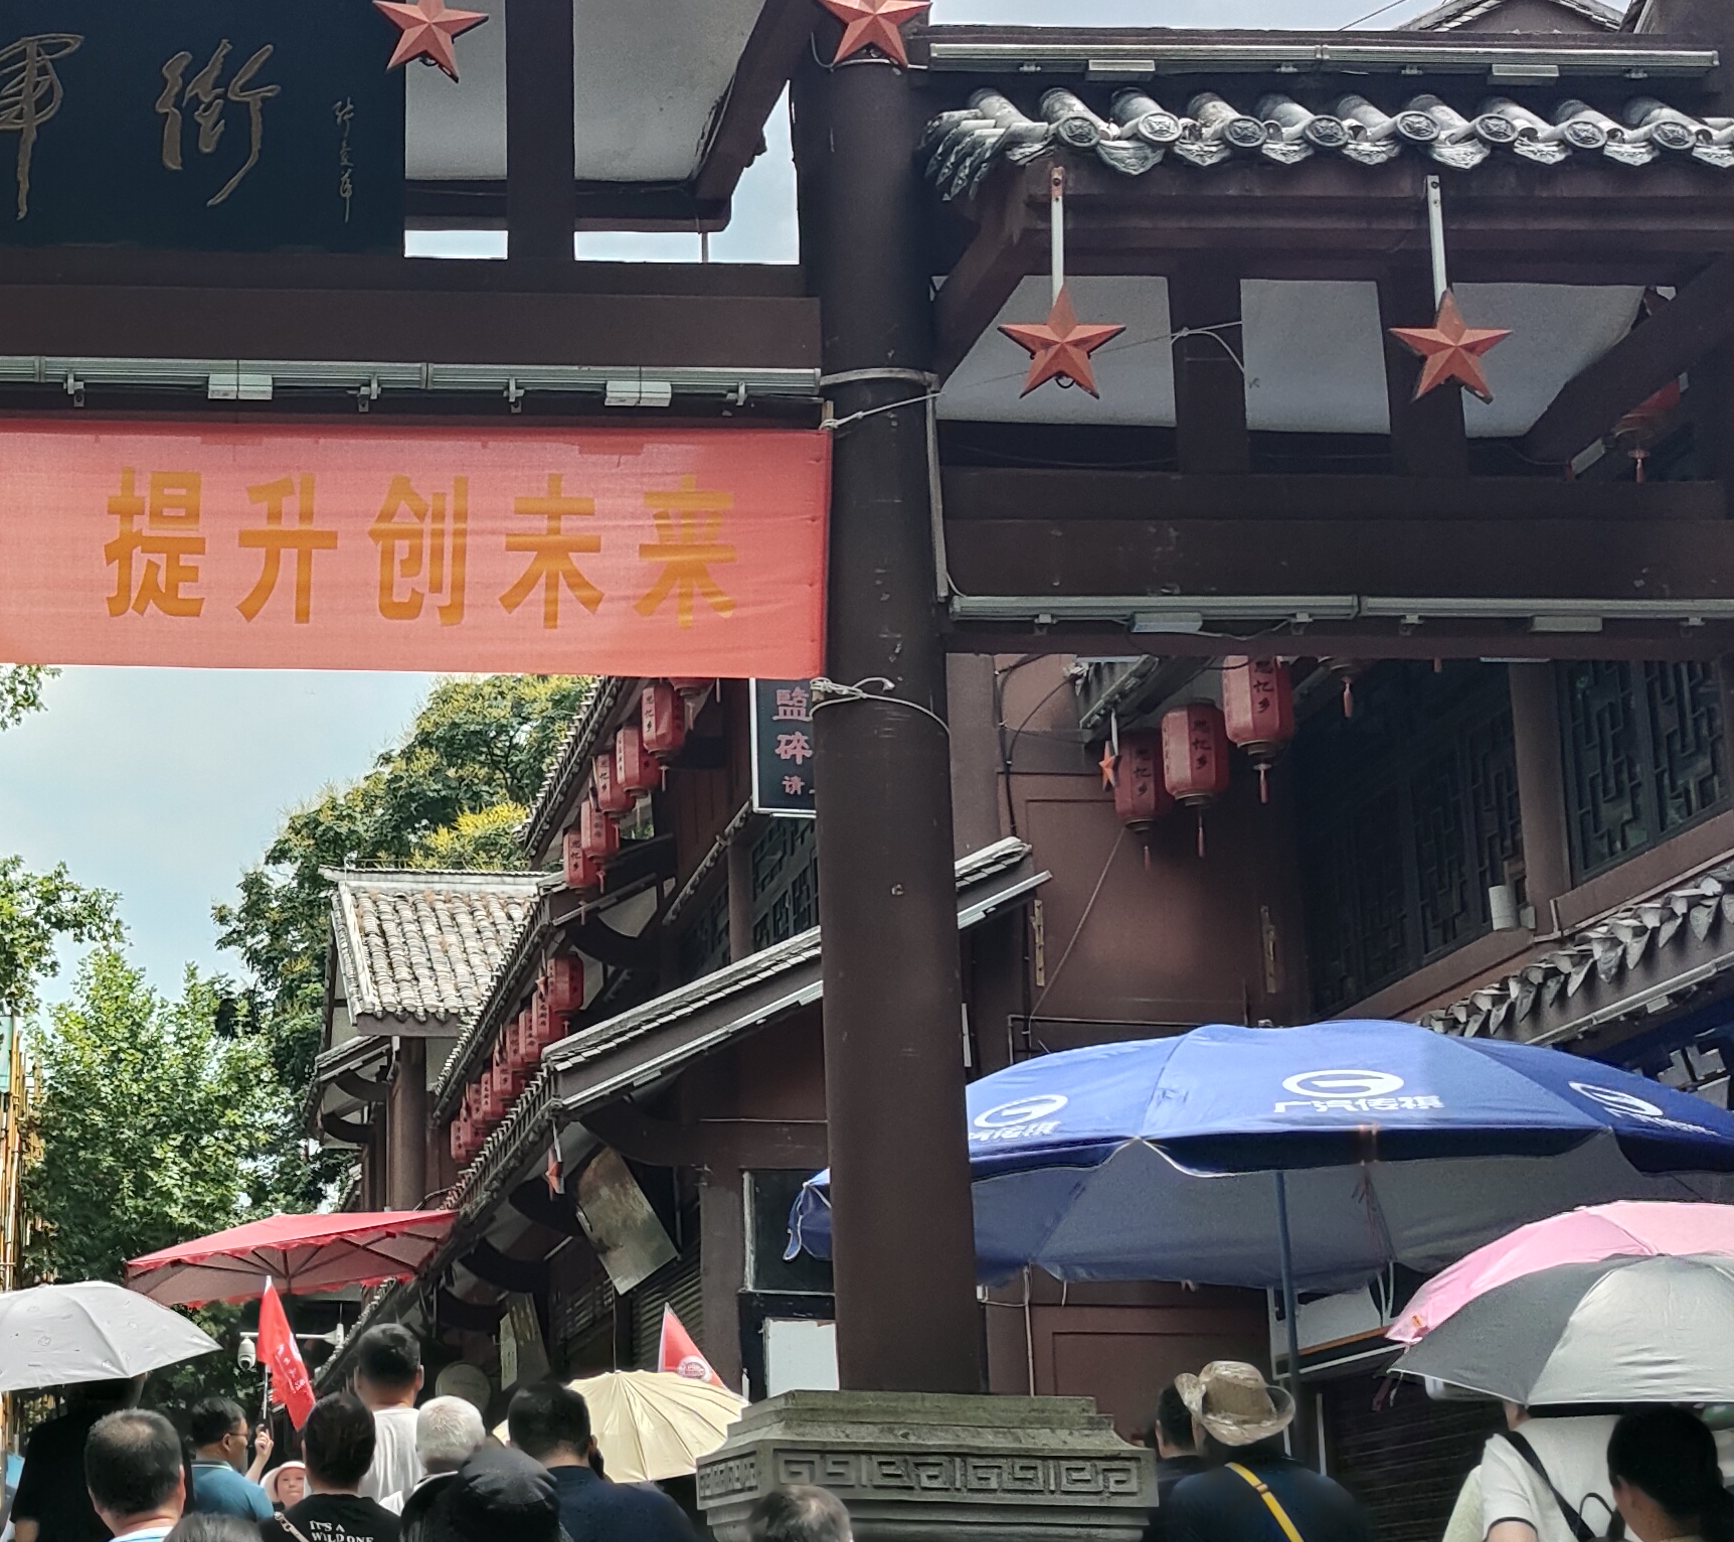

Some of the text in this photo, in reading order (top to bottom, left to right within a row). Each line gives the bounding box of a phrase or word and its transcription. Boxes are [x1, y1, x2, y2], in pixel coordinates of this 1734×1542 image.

[102, 466, 739, 631] 提升创未来
[1273, 1094, 1445, 1113] 广汽传祺
[309, 1520, 346, 1533] IT'S A
[311, 1532, 345, 1542] WILD
